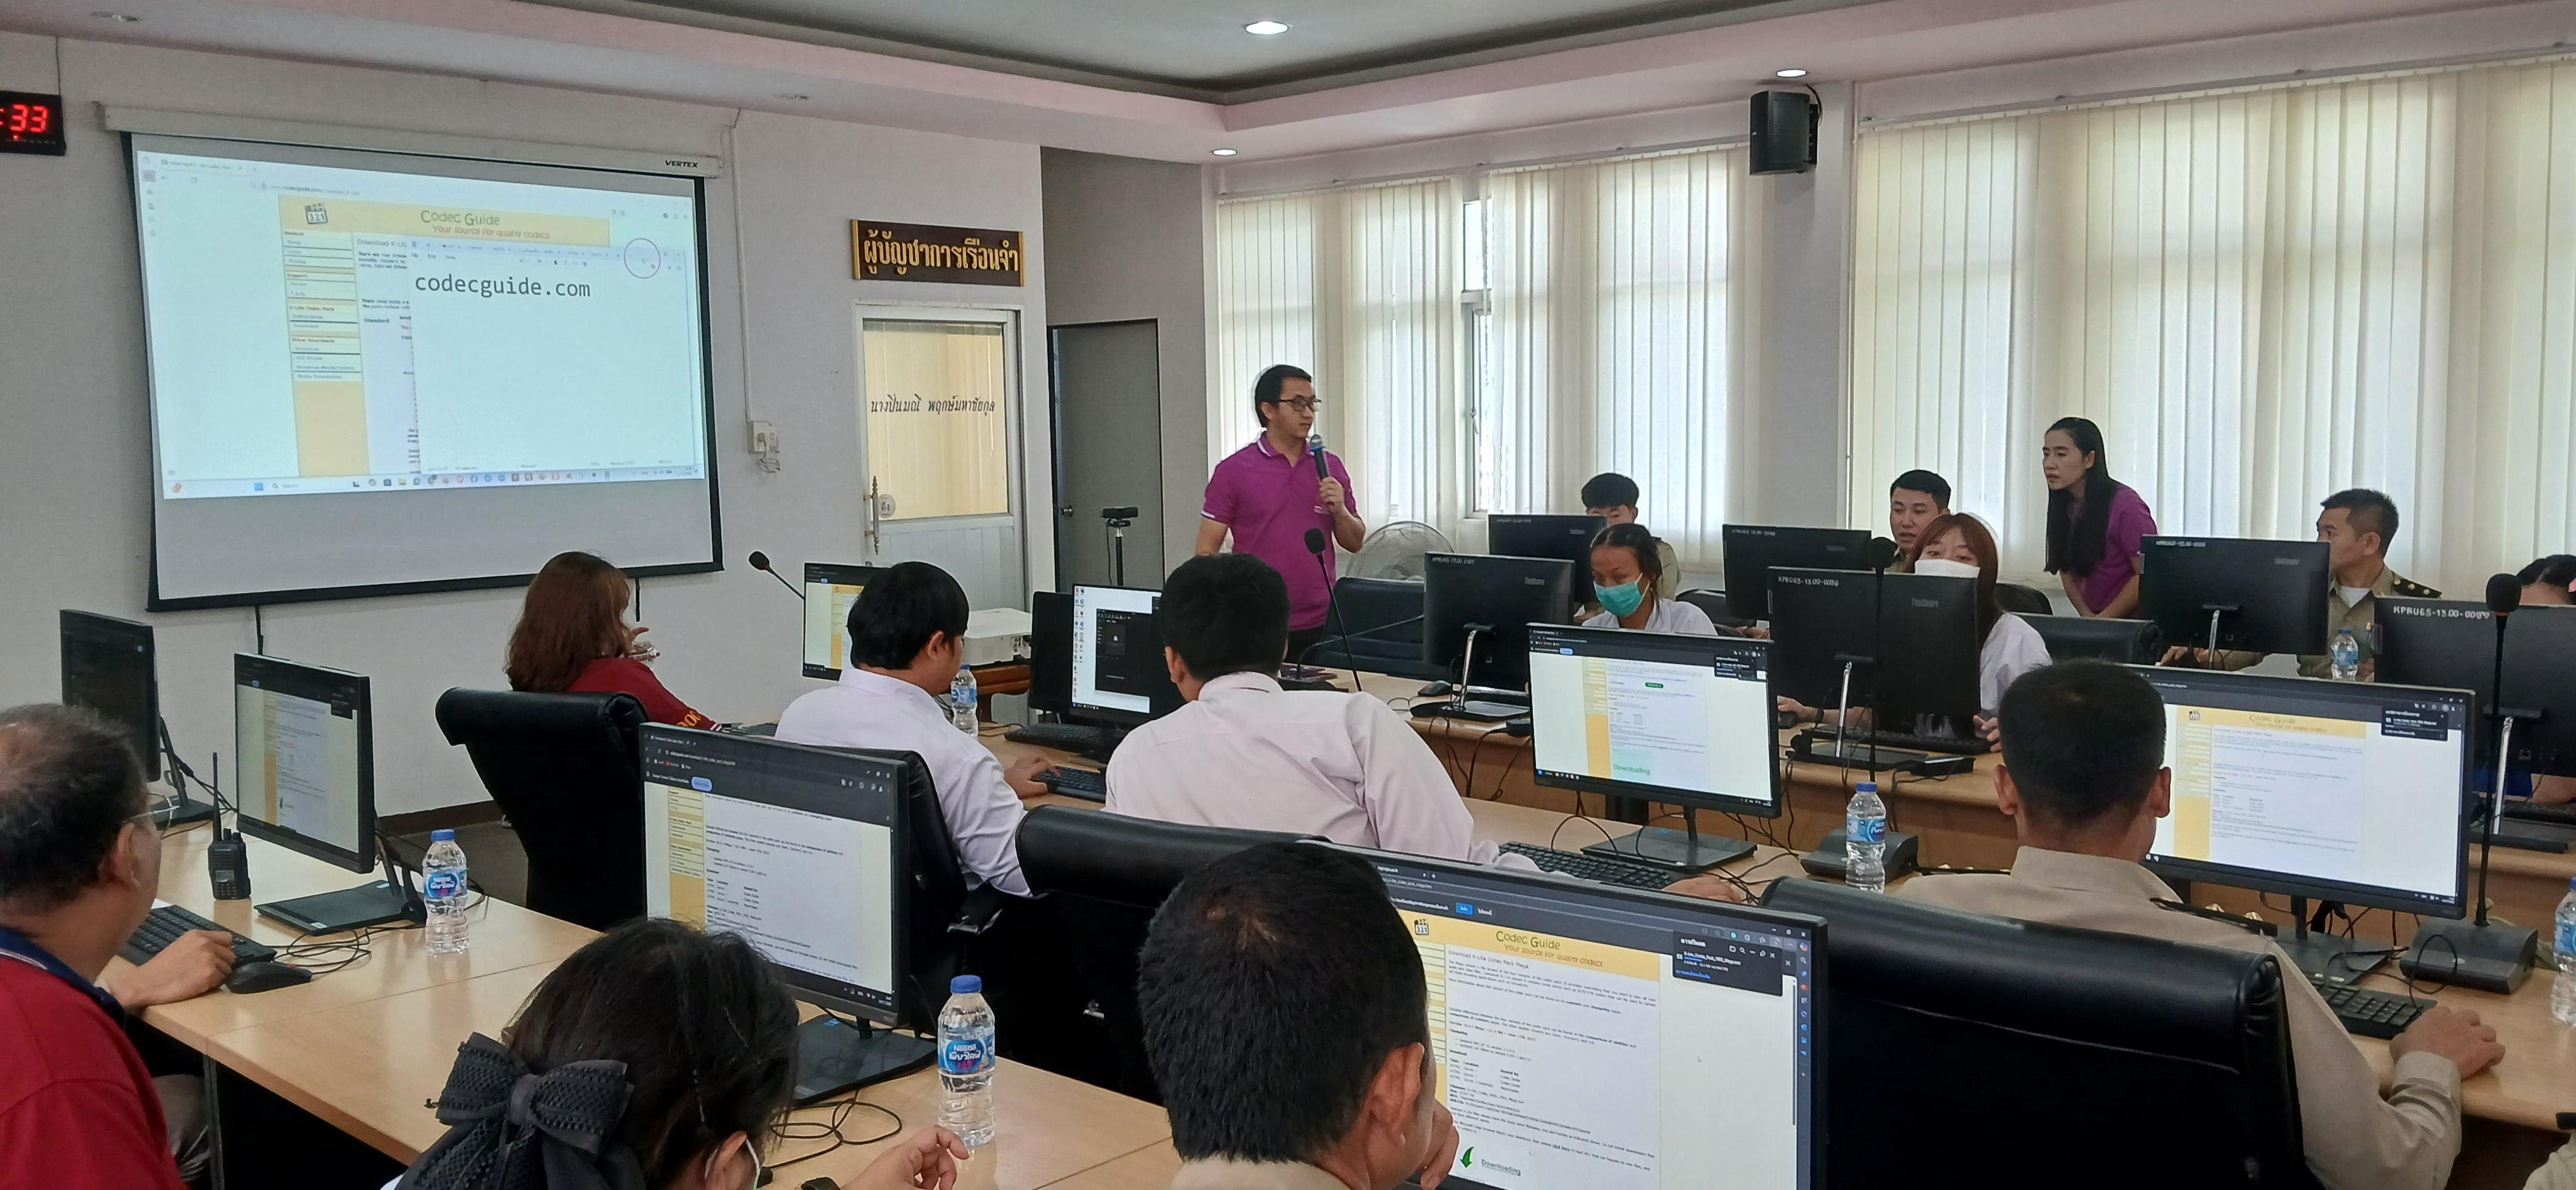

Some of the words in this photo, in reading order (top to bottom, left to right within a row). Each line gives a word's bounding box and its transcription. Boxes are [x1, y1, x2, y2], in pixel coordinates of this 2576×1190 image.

[665, 160, 698, 168] VERTEX
[421, 210, 461, 224] Codec
[465, 213, 500, 226] Guide
[455, 226, 480, 234] source
[523, 231, 550, 239] codecs
[864, 229, 1018, 275] ผู้บัญชาการเรือนจำ
[415, 273, 591, 298] codecguide.com
[1417, 925, 1428, 934] 321
[1496, 930, 1528, 944] Codec
[1530, 937, 1561, 951] Guide
[1522, 947, 1543, 957] source
[1544, 950, 1555, 958] for
[1580, 957, 1603, 967] codecs
[1481, 1159, 1521, 1176] Downloading
